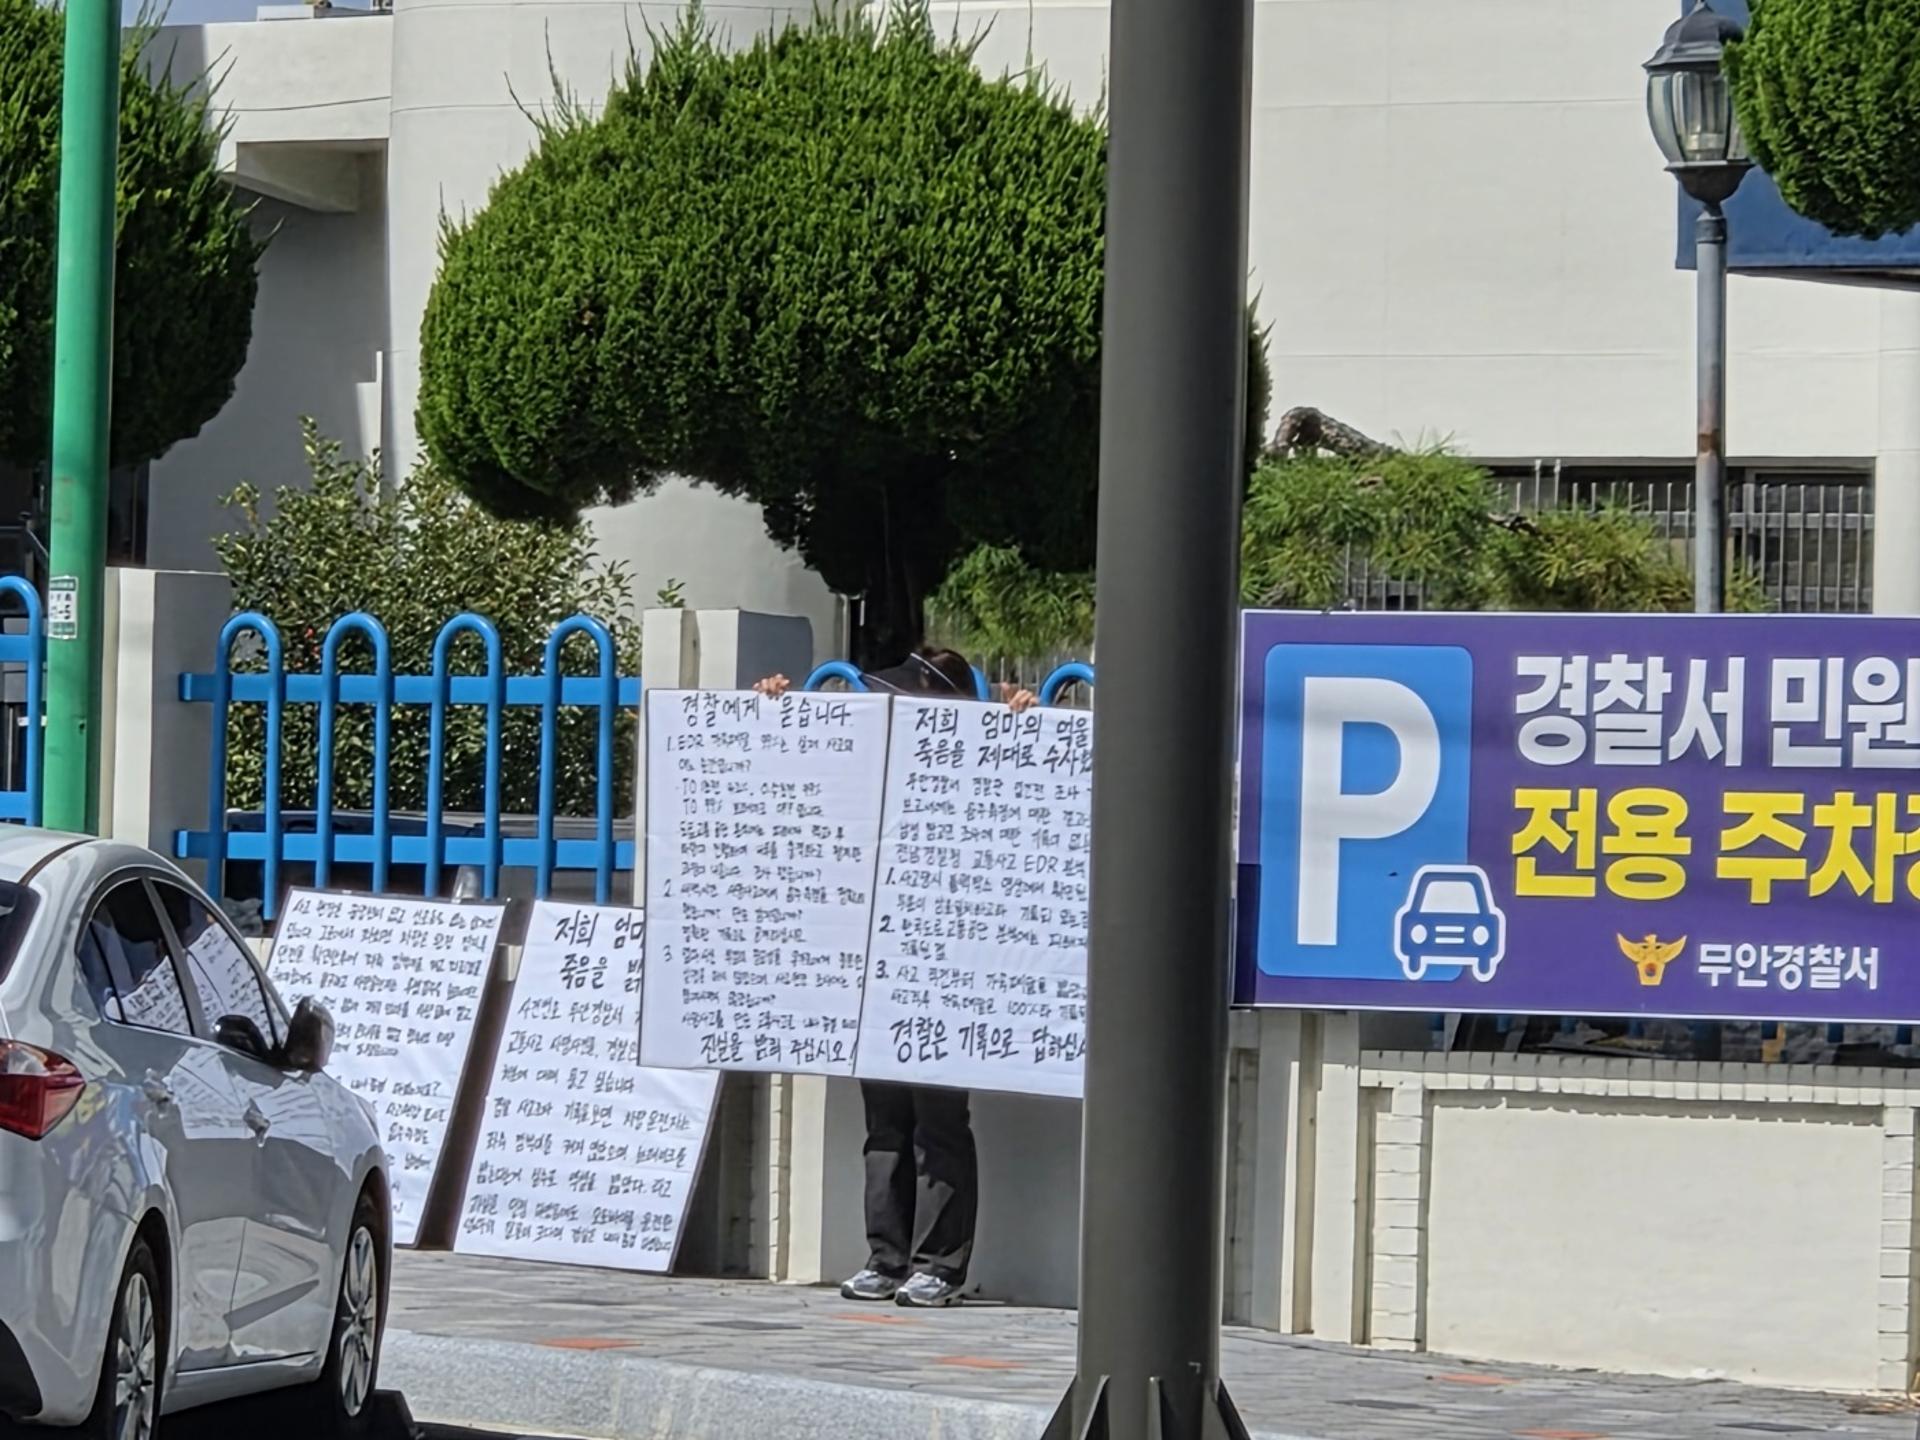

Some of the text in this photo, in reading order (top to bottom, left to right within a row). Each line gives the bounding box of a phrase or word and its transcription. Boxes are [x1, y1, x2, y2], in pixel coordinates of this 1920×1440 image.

[682, 693, 760, 728] 경찰에게
[914, 707, 960, 738] 저희
[981, 709, 1044, 743] 엄마의
[1514, 653, 1920, 769] 경찰서 민원
[914, 737, 966, 769] 죽음을
[977, 741, 1038, 772] 제대로
[1297, 676, 1441, 946] P
[1511, 786, 1692, 900] 전용
[1023, 856, 1059, 875] EDR
[554, 909, 600, 948] 저희
[560, 953, 609, 990] 죽음을
[1697, 943, 1880, 991] 무안경찰서
[700, 1031, 743, 1065] 진실을
[889, 1016, 949, 1063] 경찰은
[958, 1020, 1020, 1061] 기록으로
